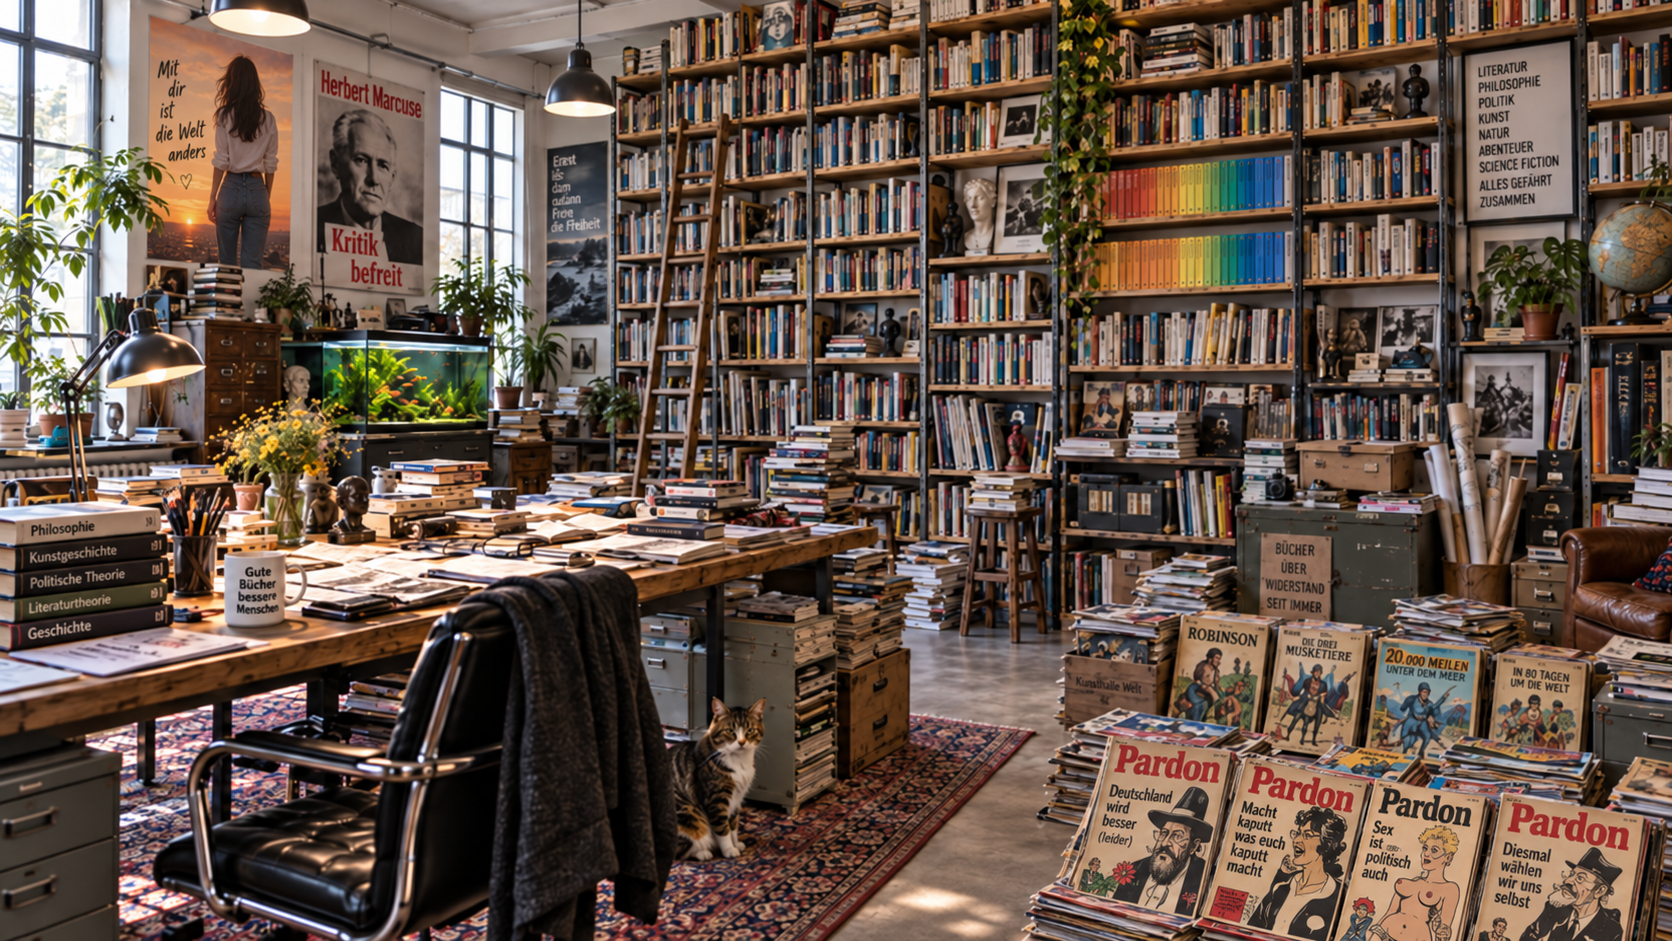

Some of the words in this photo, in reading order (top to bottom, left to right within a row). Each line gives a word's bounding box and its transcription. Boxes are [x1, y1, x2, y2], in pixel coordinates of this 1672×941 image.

[157, 59, 180, 79] Mit
[1478, 61, 1528, 78] LITERATUR
[168, 79, 186, 98] dir
[1478, 75, 1541, 93] PHILOSOPHIE
[321, 69, 369, 105] Herbert
[373, 84, 422, 118] Marcuse
[1478, 94, 1515, 109] POLITIK
[160, 101, 175, 119] ist
[1478, 110, 1510, 125] KUNST
[156, 124, 173, 143] die
[179, 120, 206, 140] Welt
[1479, 126, 1510, 141] NATUR
[168, 143, 206, 161] anders
[1479, 140, 1534, 157] ABENTEUER
[1479, 158, 1518, 173] SCIENCE
[1521, 154, 1559, 170] FICTION
[1479, 178, 1508, 192] ALLES
[1511, 173, 1552, 189] GEFÄHRT
[1480, 193, 1535, 208] ZUSAMMEN
[332, 227, 379, 257] Kritik
[351, 259, 403, 287] befreit
[31, 520, 95, 537] Philosophie
[29, 545, 117, 564] Kunstgeschichte
[1275, 540, 1315, 556] BÜCHER
[245, 566, 272, 577] Gute
[1281, 558, 1307, 575] ÜBER
[30, 574, 82, 589] Politische
[85, 568, 125, 583] Theorie
[239, 579, 276, 590] Bücher
[1265, 578, 1325, 595] WIDERSTAND
[28, 594, 112, 614] Literaturtheorie
[238, 591, 277, 602] bessere
[1266, 597, 1287, 610] SEIT
[1289, 599, 1322, 613] IMMER
[236, 604, 279, 614] Menschen
[27, 620, 92, 640] Geschichte
[1187, 626, 1259, 648] ROBINSON
[1317, 639, 1338, 649] DREI
[1285, 645, 1352, 662] MUSKETIERE
[1385, 647, 1426, 667] 20.000
[1427, 657, 1469, 673] MEILEN
[1386, 664, 1415, 677] UNTER
[1417, 666, 1436, 679] DEM
[1438, 670, 1466, 682] MEER
[1512, 667, 1523, 677] IN
[1525, 668, 1537, 680] 80
[1539, 670, 1570, 683] TAGEN
[1122, 682, 1142, 694] Welt
[1510, 679, 1525, 689] UM
[1528, 679, 1542, 690] DIE
[1544, 681, 1570, 694] WELT
[1114, 743, 1221, 784] Pardon
[1108, 784, 1173, 804] Deutschland
[1247, 765, 1355, 813] Pardon
[1106, 800, 1131, 815] wird
[1241, 800, 1278, 819] Macht
[1378, 787, 1472, 827] Pardon
[1102, 814, 1137, 830] besser
[1237, 814, 1273, 833] kaputt
[1372, 820, 1394, 836] Sex
[1507, 802, 1630, 851] Pardon
[1098, 831, 1133, 848] (leider)
[1235, 831, 1257, 845] was
[1259, 834, 1286, 850] euch
[1369, 835, 1384, 849] ist
[1230, 843, 1269, 863] kaputt
[1364, 852, 1411, 870] politisch
[1502, 841, 1552, 863] Diesmal
[1226, 861, 1264, 878] macht
[1361, 866, 1389, 882] auch
[1500, 859, 1542, 878] wählen
[1498, 875, 1518, 889] wir
[1520, 880, 1542, 894] uns
[1494, 891, 1531, 909] selbst
